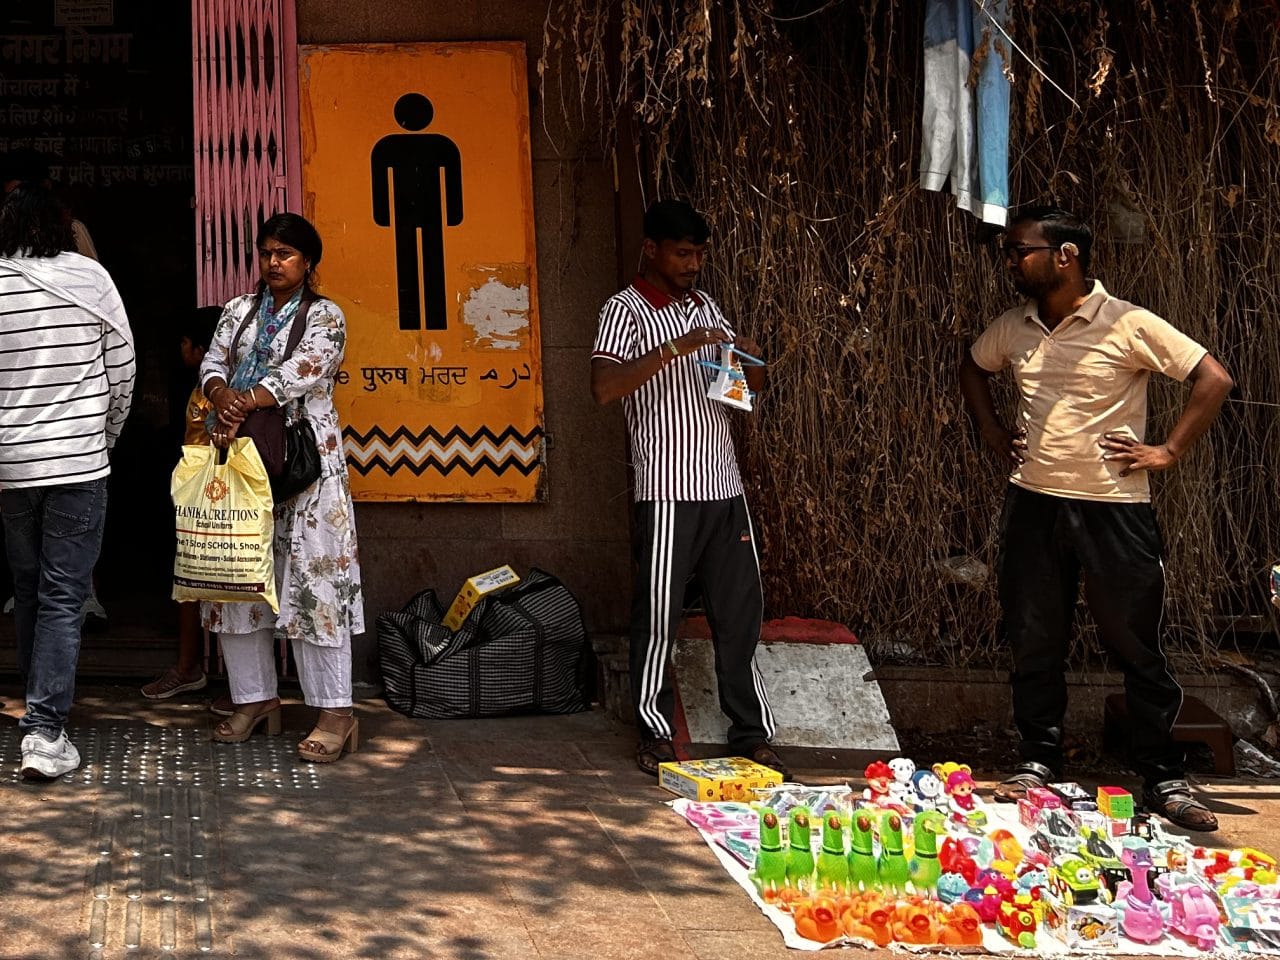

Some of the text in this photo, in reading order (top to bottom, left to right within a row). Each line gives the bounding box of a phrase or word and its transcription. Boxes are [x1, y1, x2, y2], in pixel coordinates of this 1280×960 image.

[1, 34, 63, 66] नगर
[360, 367, 409, 392] पुरुष
[419, 367, 468, 386] ਮਰਦ
